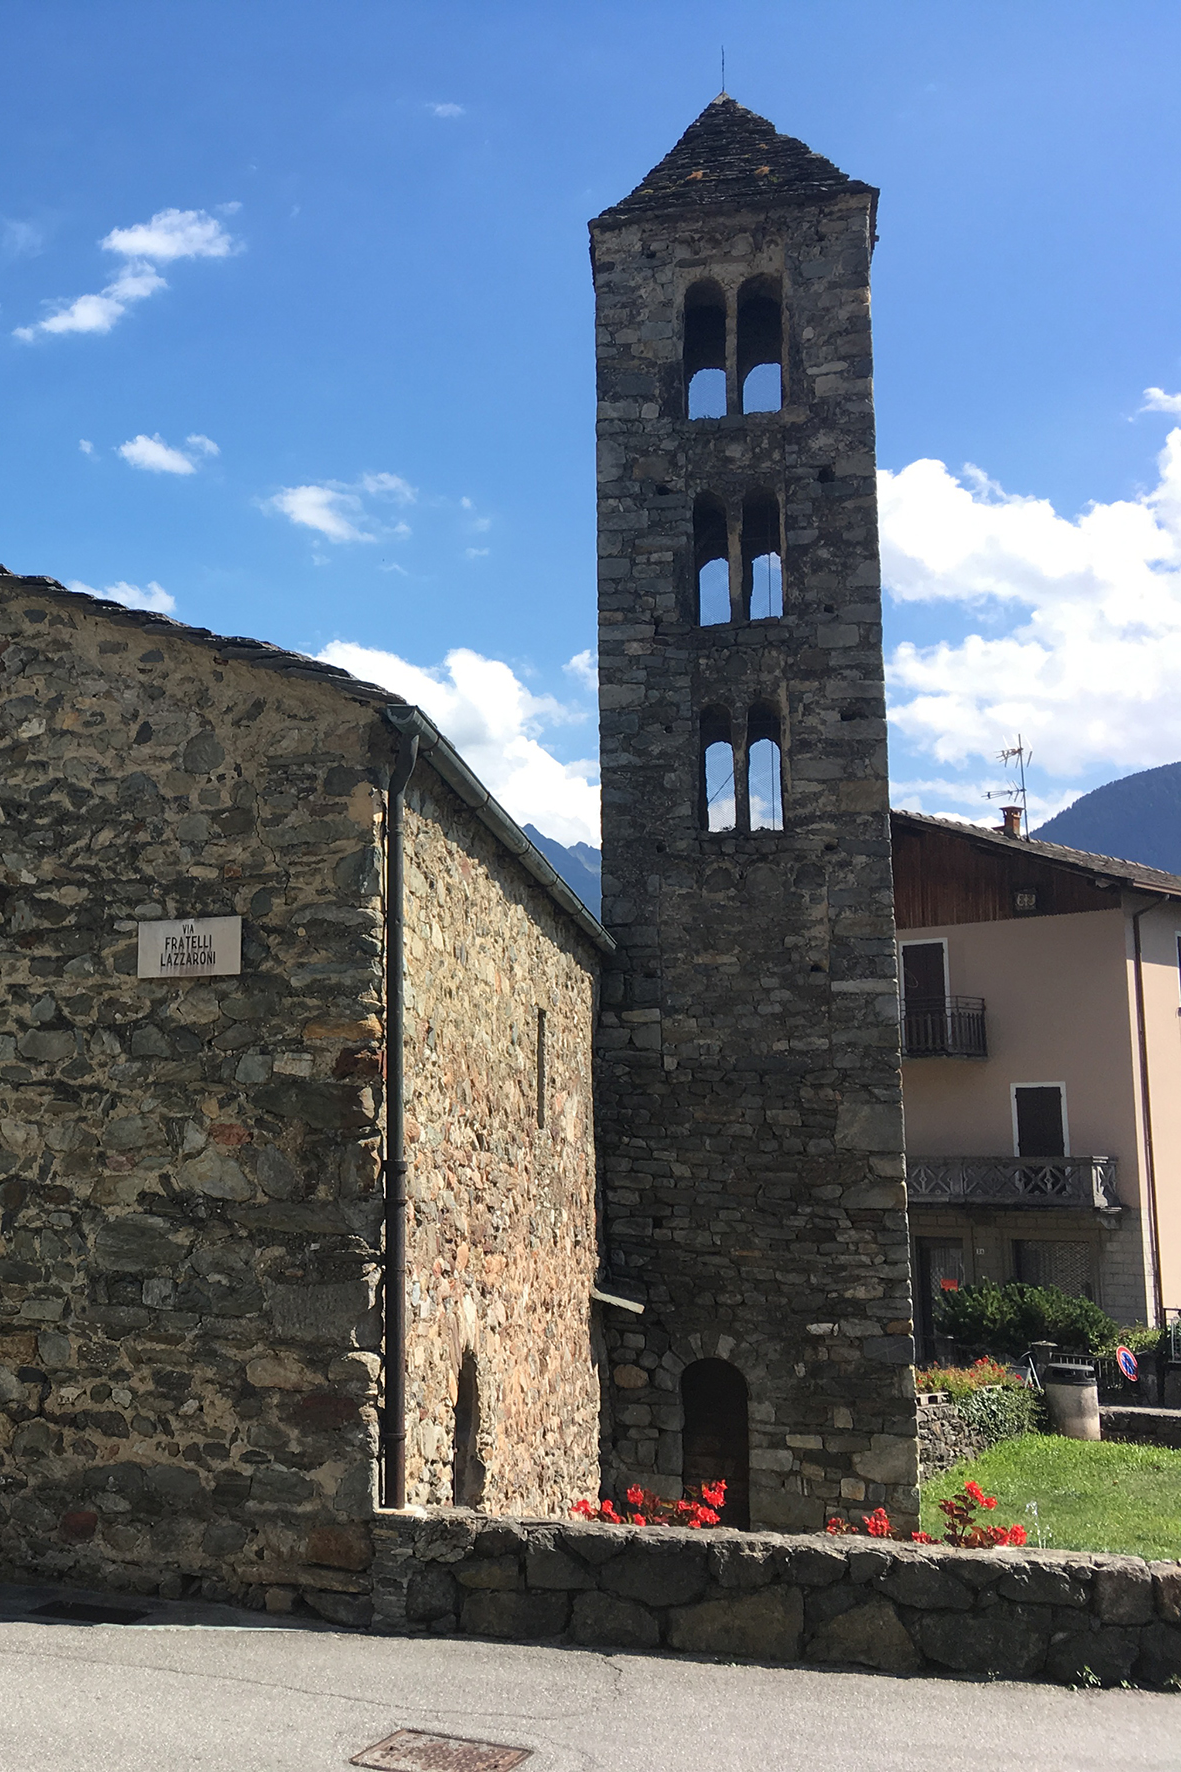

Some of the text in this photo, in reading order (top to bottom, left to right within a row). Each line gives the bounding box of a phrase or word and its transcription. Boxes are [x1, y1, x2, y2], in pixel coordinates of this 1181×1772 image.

[182, 924, 194, 934] VIA
[165, 935, 212, 950] FRATELLI
[160, 951, 216, 967] LAZZARONI
